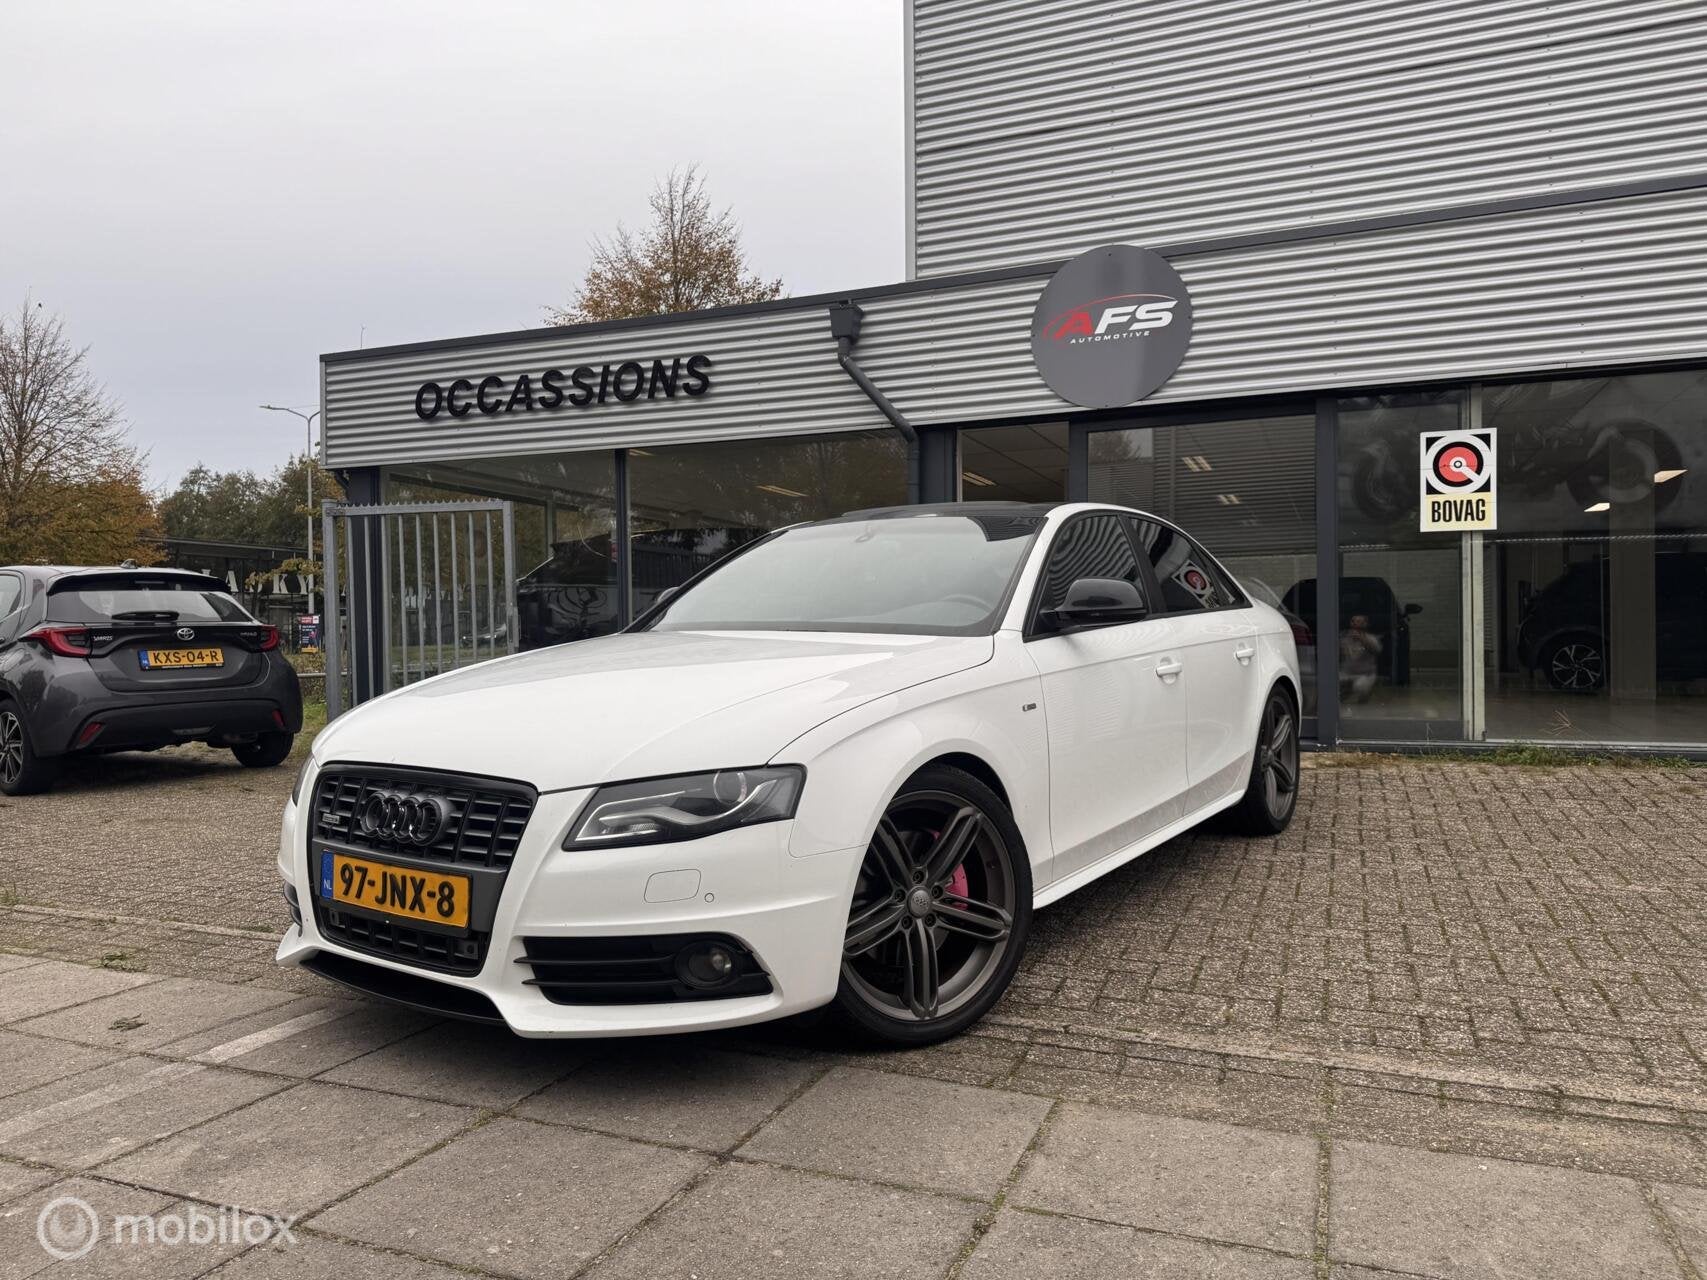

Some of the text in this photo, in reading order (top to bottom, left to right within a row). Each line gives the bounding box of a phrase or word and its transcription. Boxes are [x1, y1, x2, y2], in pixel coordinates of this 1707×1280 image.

[1054, 300, 1178, 341] AFS
[1070, 331, 1151, 344] AUTOMOTIVE
[415, 354, 712, 420] OCCASSIONS
[1431, 498, 1486, 523] BOVAG
[152, 650, 219, 664] KXS-04-R
[323, 877, 332, 890] NL
[340, 862, 455, 917] 97-JNX-8
